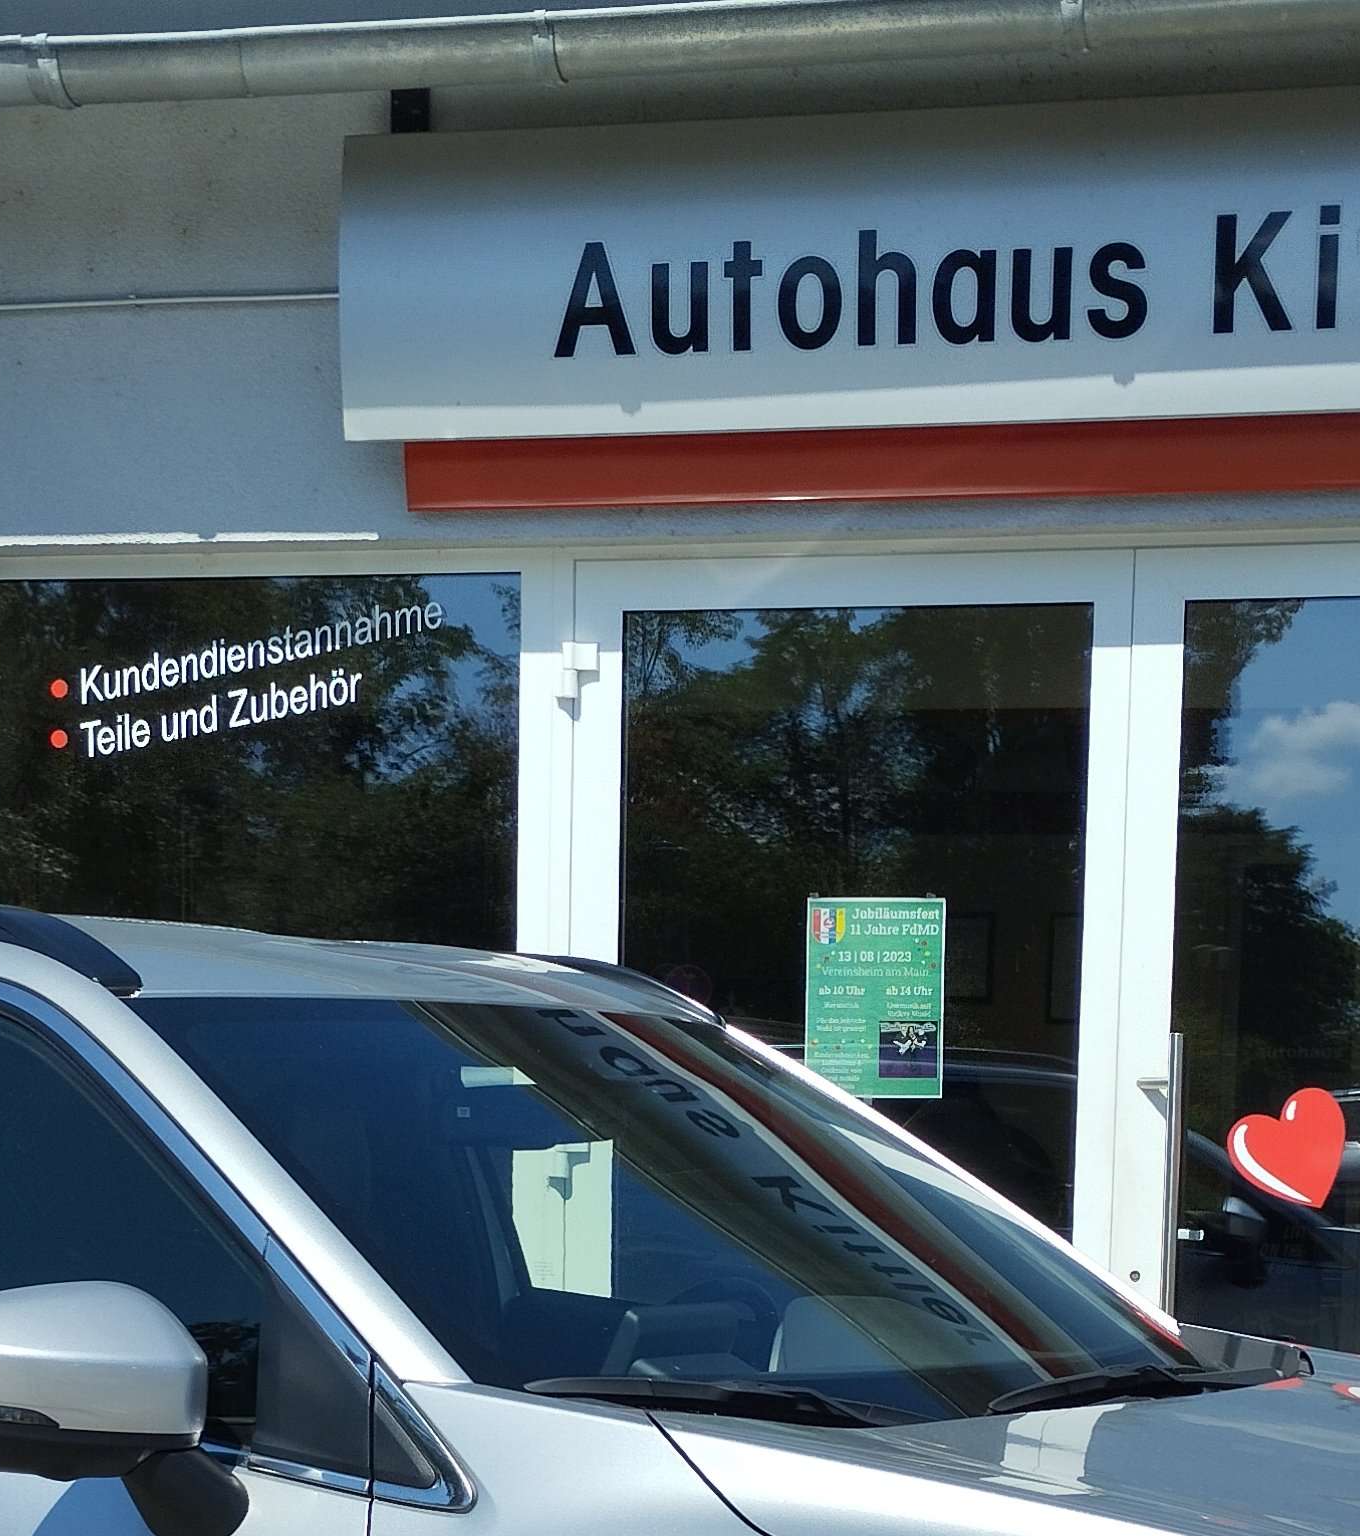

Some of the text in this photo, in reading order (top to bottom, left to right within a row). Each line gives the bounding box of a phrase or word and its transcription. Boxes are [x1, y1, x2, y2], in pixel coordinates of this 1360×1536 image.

[552, 228, 1150, 360] Autohaus
[78, 599, 444, 706] Kundendienstannahme
[79, 668, 363, 758] Teile und Zubehör
[851, 907, 940, 921] Jubiläumsfest
[863, 924, 900, 936] Jahre
